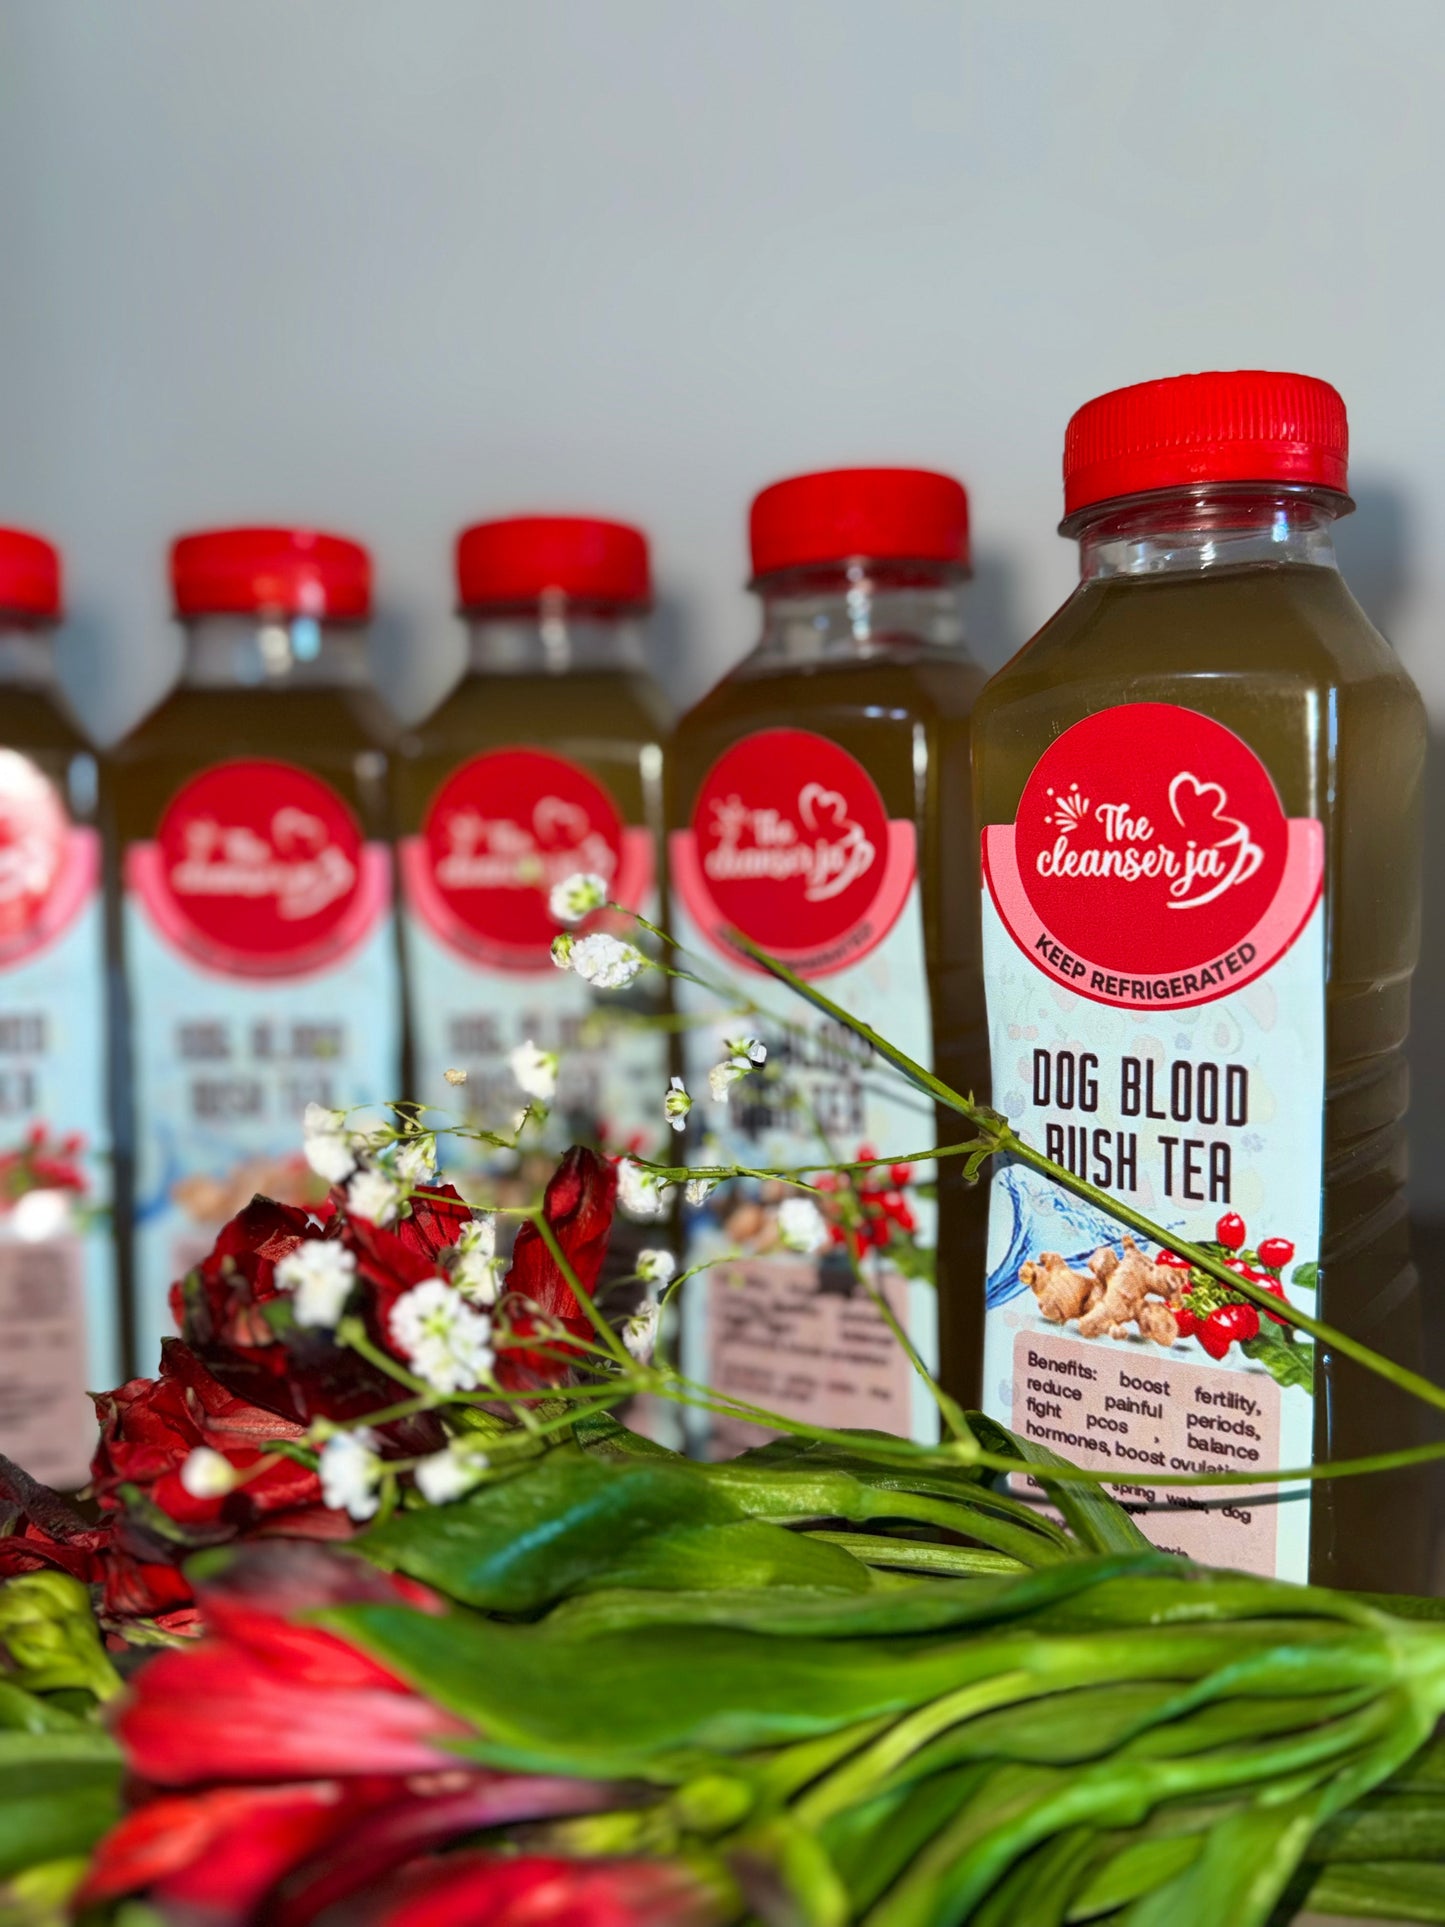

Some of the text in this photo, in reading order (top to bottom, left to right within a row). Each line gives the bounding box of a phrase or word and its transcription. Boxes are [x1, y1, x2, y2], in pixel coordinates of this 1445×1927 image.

[1095, 803, 1154, 842] The
[1035, 933, 1257, 1000] KEEP REFRIGERATED
[1033, 1049, 1248, 1127] DOG BLOOD
[1158, 1135, 1231, 1204] TEA
[1026, 1377, 1261, 1441] reduce painful periods,
[1027, 1350, 1262, 1416] Benefits: boost fertility,
[1026, 1396, 1063, 1419] fight
[1086, 1413, 1128, 1434] pcos
[1187, 1432, 1260, 1461] balance
[1026, 1419, 1111, 1456] hormones,
[1115, 1441, 1166, 1467] boost
[1222, 1504, 1252, 1524] dog
